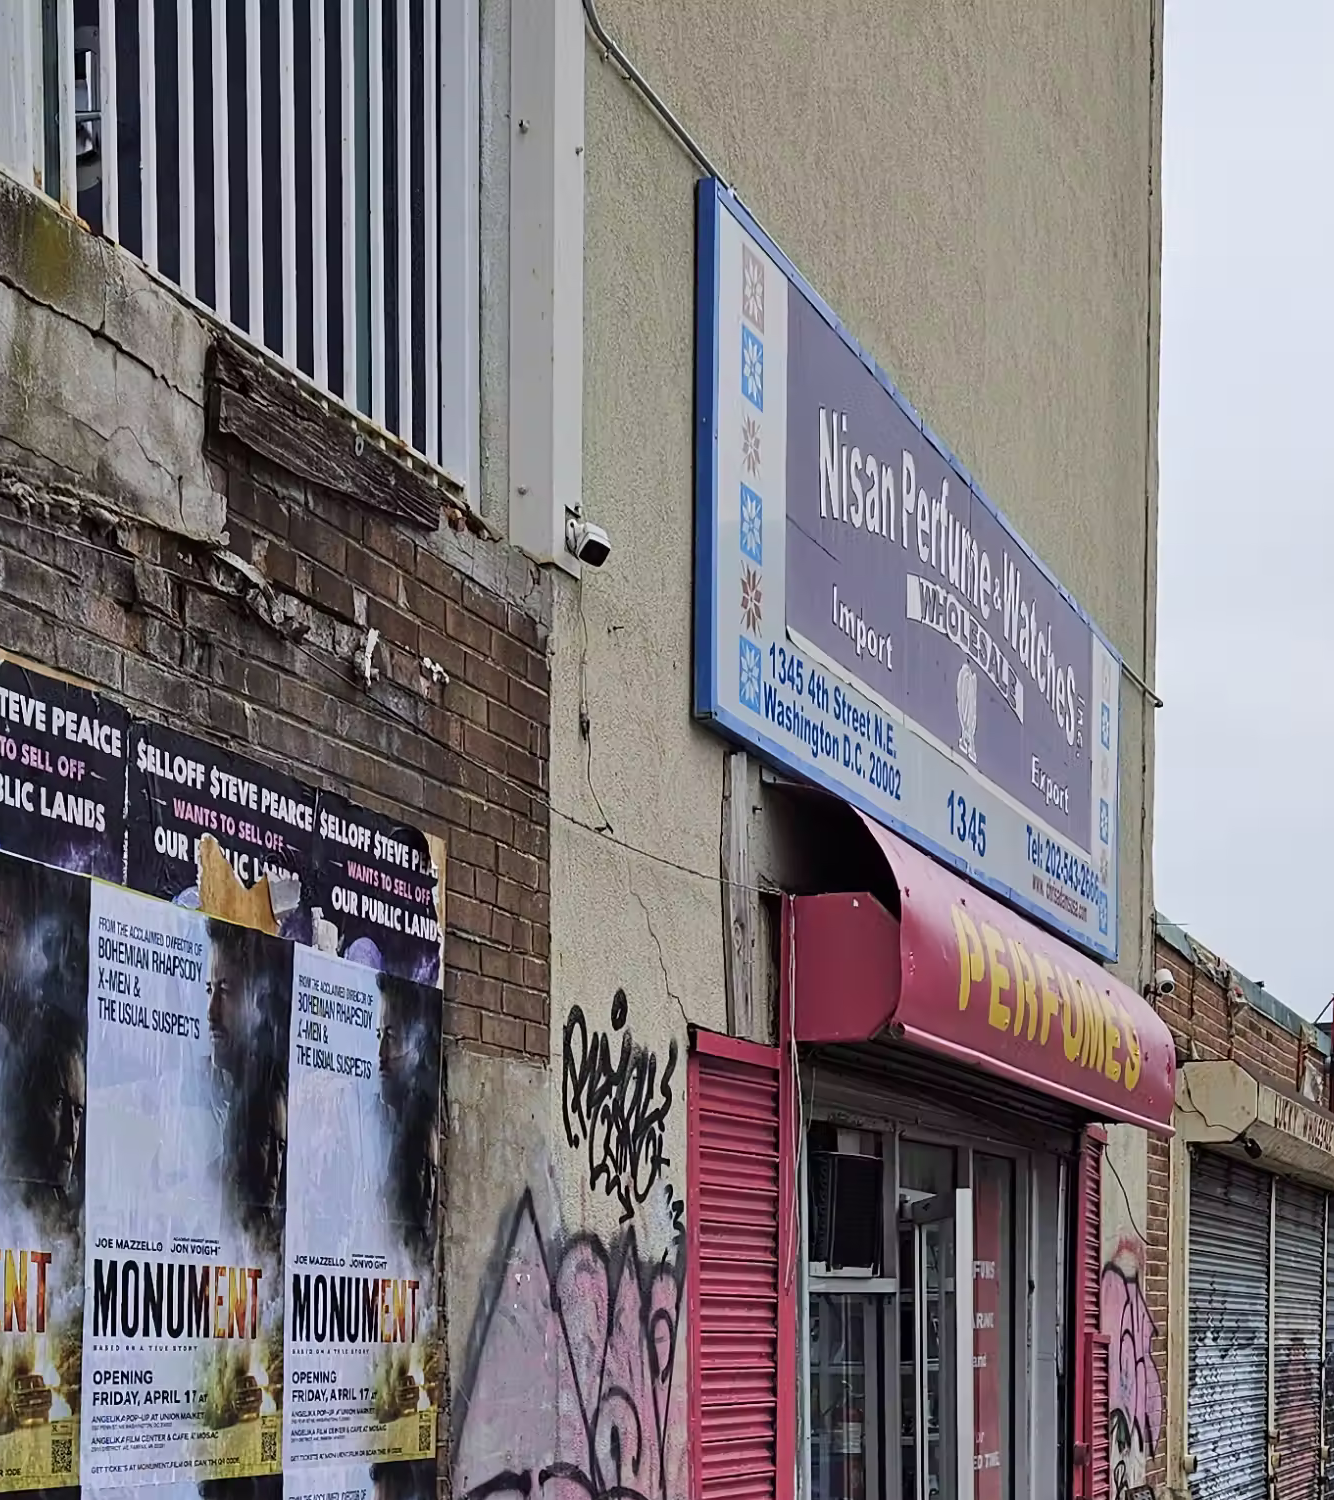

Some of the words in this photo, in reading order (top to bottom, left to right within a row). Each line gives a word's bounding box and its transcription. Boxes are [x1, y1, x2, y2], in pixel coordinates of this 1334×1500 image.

[819, 406, 895, 542] Nisan
[902, 449, 992, 620] Perfume
[993, 577, 1002, 612] &
[1003, 549, 1076, 746] Watches
[832, 583, 894, 672] Import
[919, 577, 1020, 708] WHOLESALE
[769, 642, 804, 695] 1345
[808, 669, 829, 714] 4th
[833, 685, 871, 742] Street
[874, 713, 897, 759] N.E.
[21, 743, 53, 773] SELL
[57, 756, 85, 782] OFF
[763, 681, 840, 762] Washington
[843, 733, 866, 779] D.C.
[869, 751, 902, 801] 20002
[40, 787, 105, 832] LANDS
[261, 787, 313, 831] PEARCE
[1031, 753, 1069, 815] Export
[155, 826, 188, 861] OUR
[173, 798, 217, 830] WANTS
[220, 814, 235, 836] TO
[238, 821, 262, 846] SELL
[265, 831, 284, 852] OFF
[947, 790, 986, 857] 1345
[1027, 824, 1043, 869] Tel:
[332, 886, 358, 916] OUR
[362, 895, 402, 931] PUBLIC
[347, 860, 379, 887] WANTS
[381, 873, 392, 891] TO
[394, 879, 412, 900] SELL
[415, 886, 431, 905] OFF
[951, 903, 1144, 1092] PERFUMES
[92, 1257, 266, 1339] MONUMENT
[292, 1272, 419, 1343] MONUMENT
[92, 1370, 152, 1385] OPENING
[292, 1370, 336, 1385] OPENING
